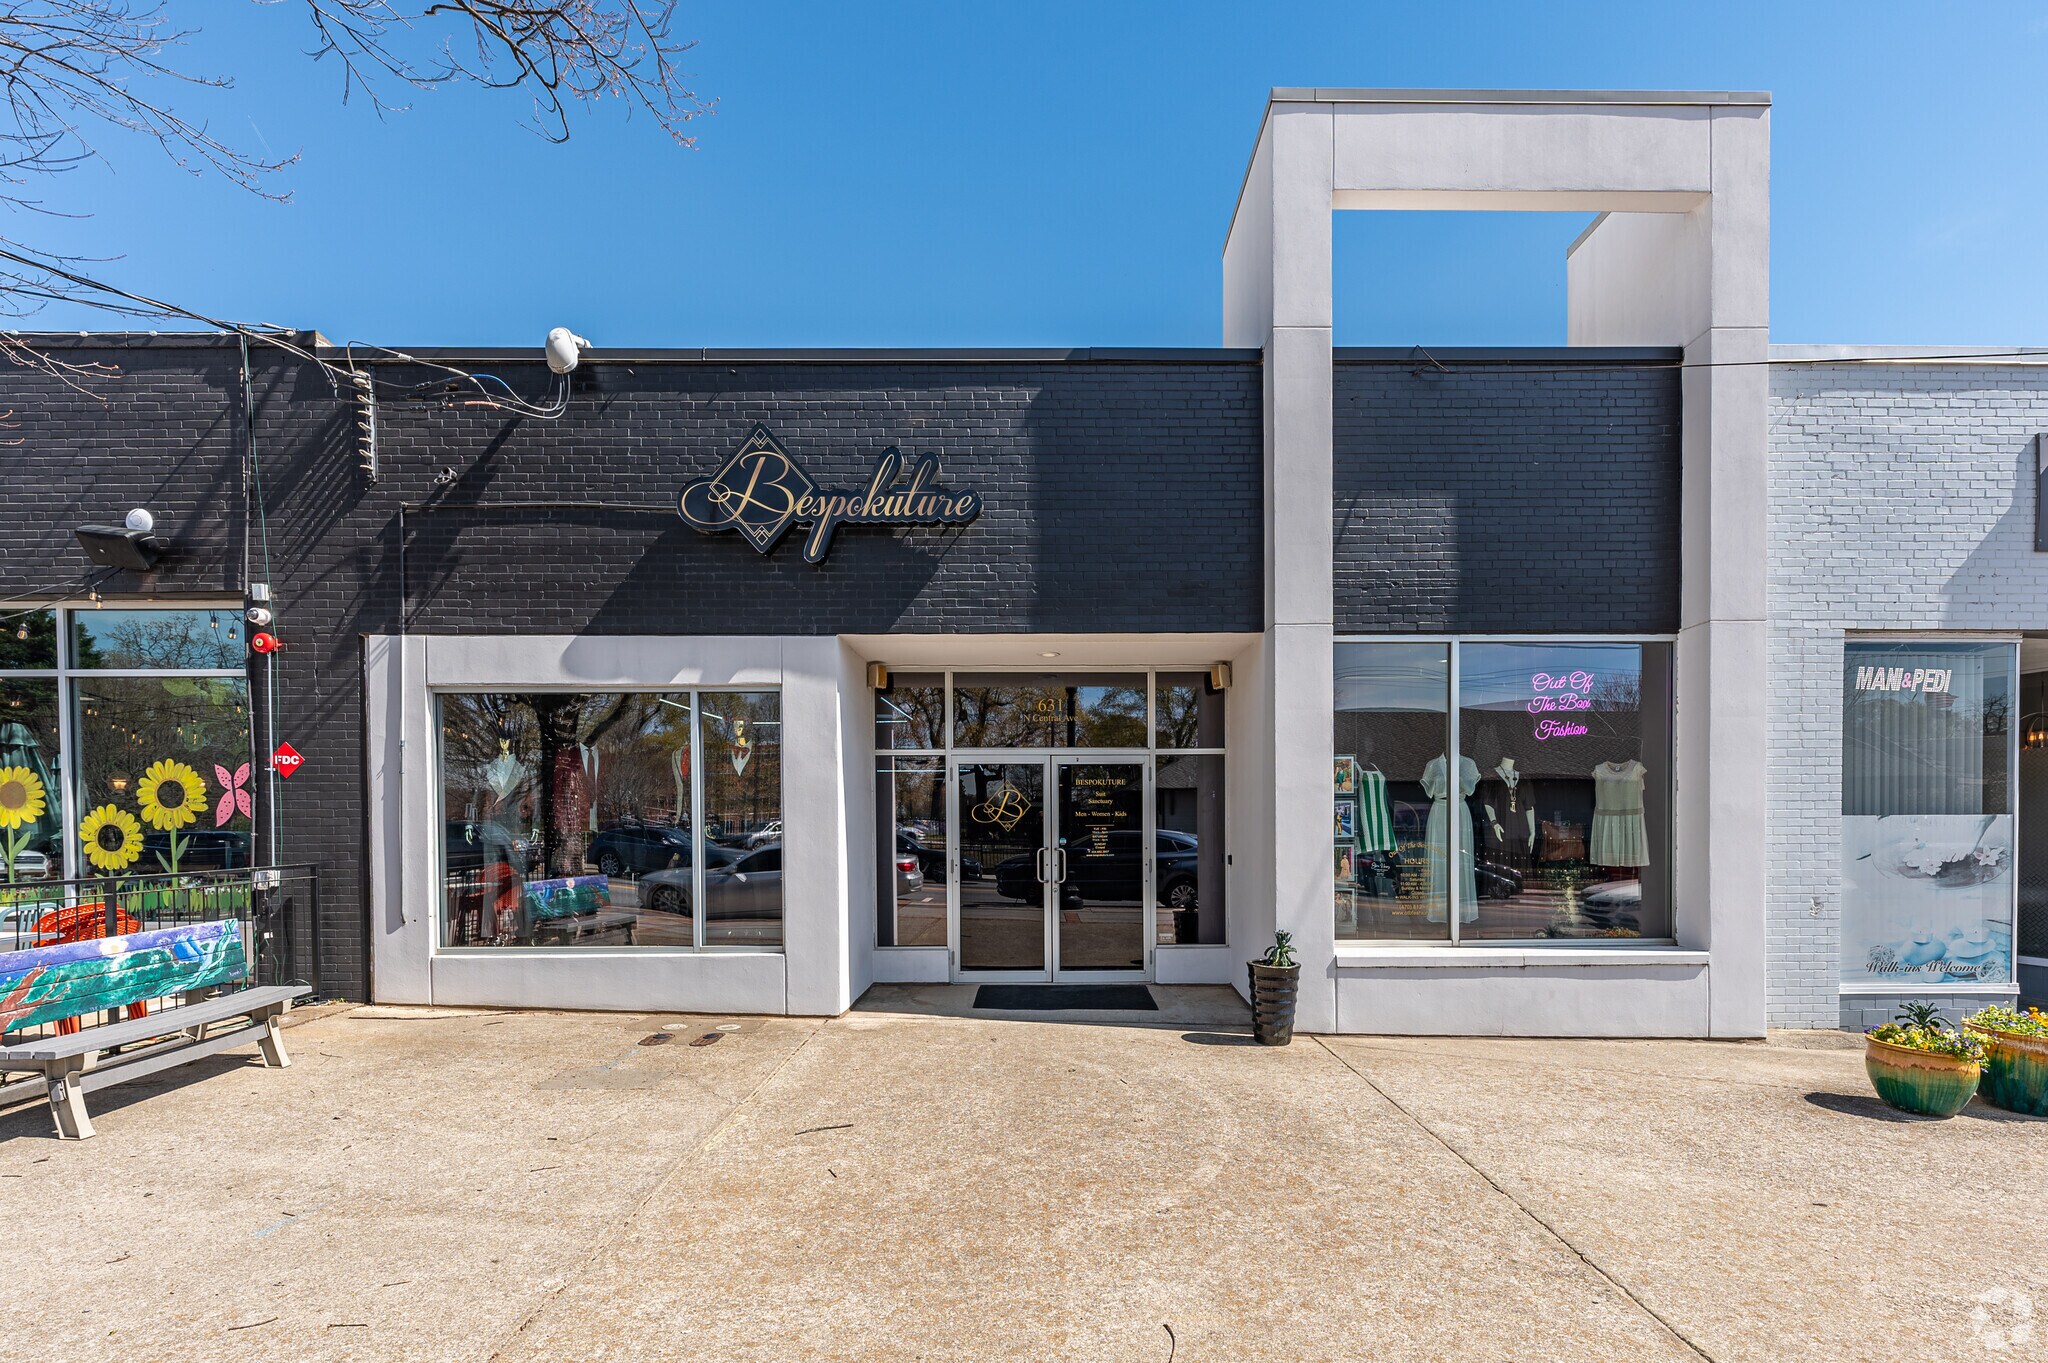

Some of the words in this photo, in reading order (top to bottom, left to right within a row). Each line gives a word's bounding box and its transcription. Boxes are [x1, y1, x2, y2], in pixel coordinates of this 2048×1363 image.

[682, 451, 975, 557] Bespokuture
[1532, 672, 1567, 691] Out
[1570, 670, 1595, 694] Of
[1038, 698, 1063, 712] 631
[1527, 696, 1557, 714] The
[1558, 692, 1591, 711] Box
[1023, 713, 1031, 722] N
[1032, 713, 1062, 722] Central
[1063, 714, 1078, 722] Ave
[1534, 719, 1588, 740] Fashion
[274, 755, 300, 765] FDC
[1866, 961, 1922, 973] Walk-ins
[1926, 959, 1980, 973] Welcome
